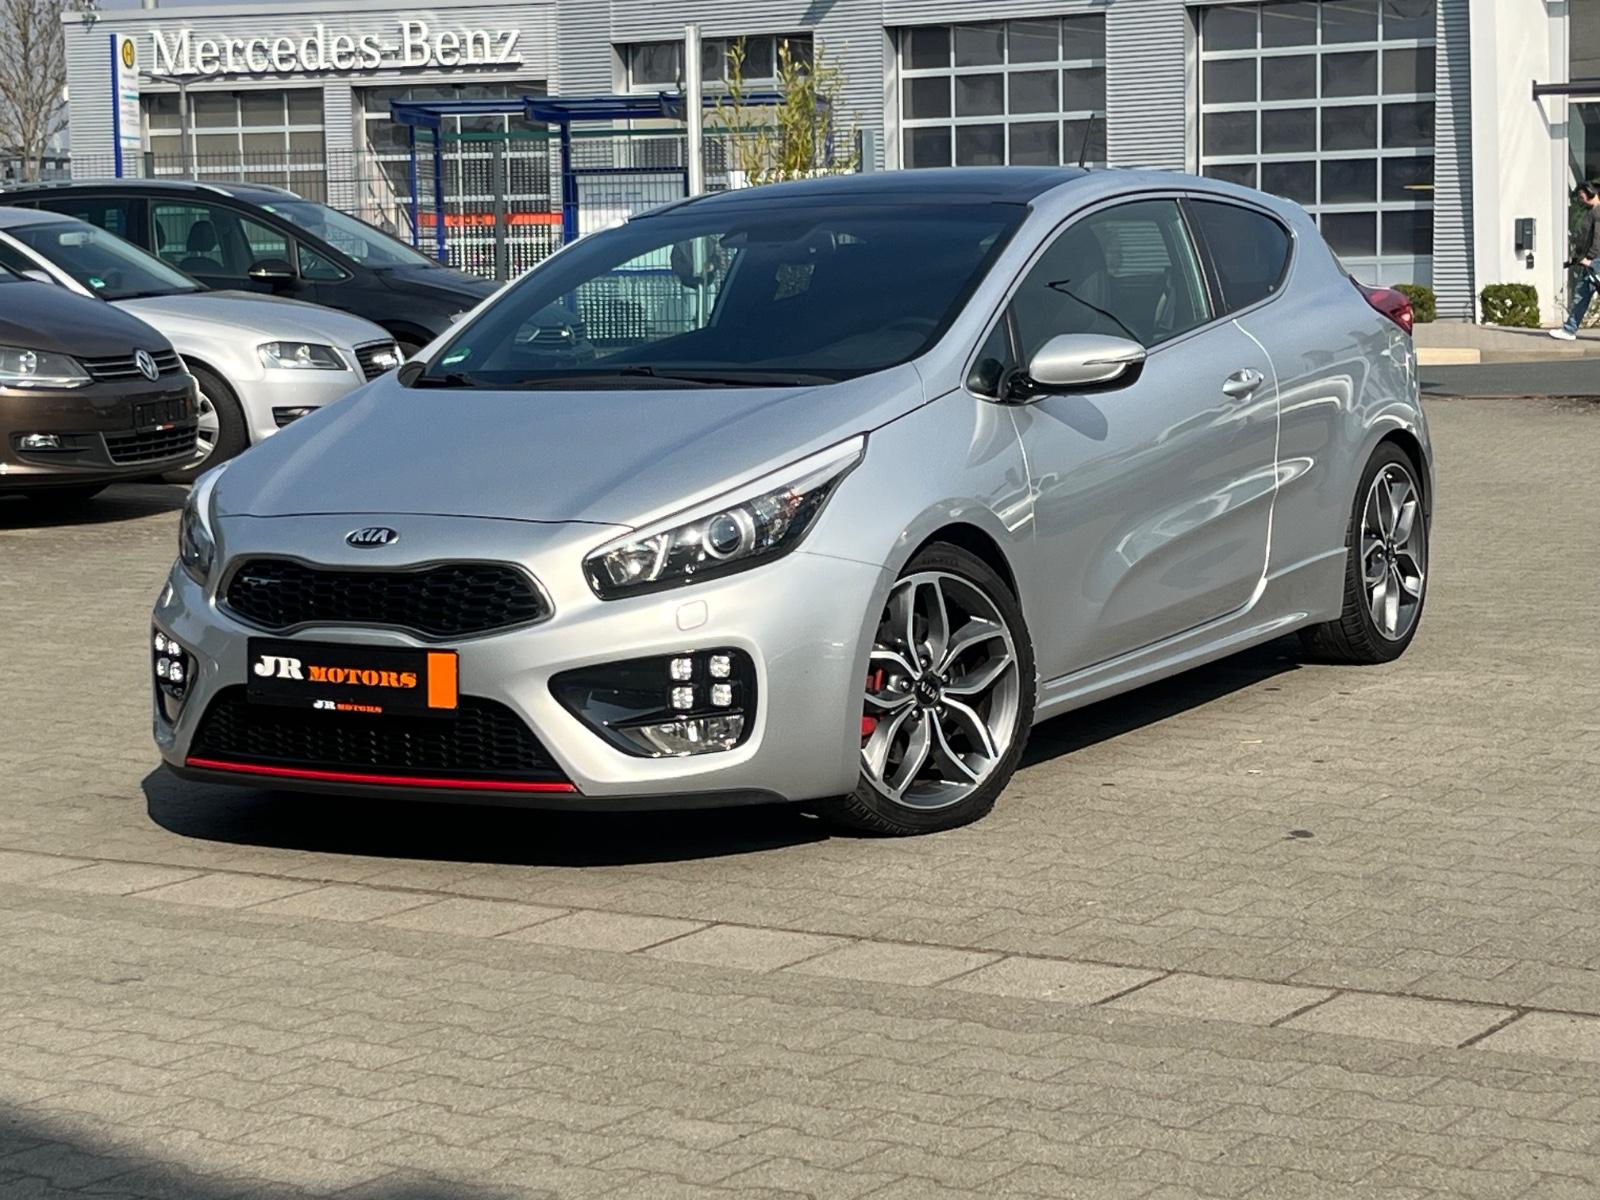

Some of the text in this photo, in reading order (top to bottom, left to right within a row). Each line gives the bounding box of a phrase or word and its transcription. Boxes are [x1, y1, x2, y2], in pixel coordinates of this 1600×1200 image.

[151, 20, 522, 74] Mercedes-Benz
[351, 529, 389, 543] KIA
[253, 654, 417, 689] JR MOTORS
[313, 699, 336, 711] JR
